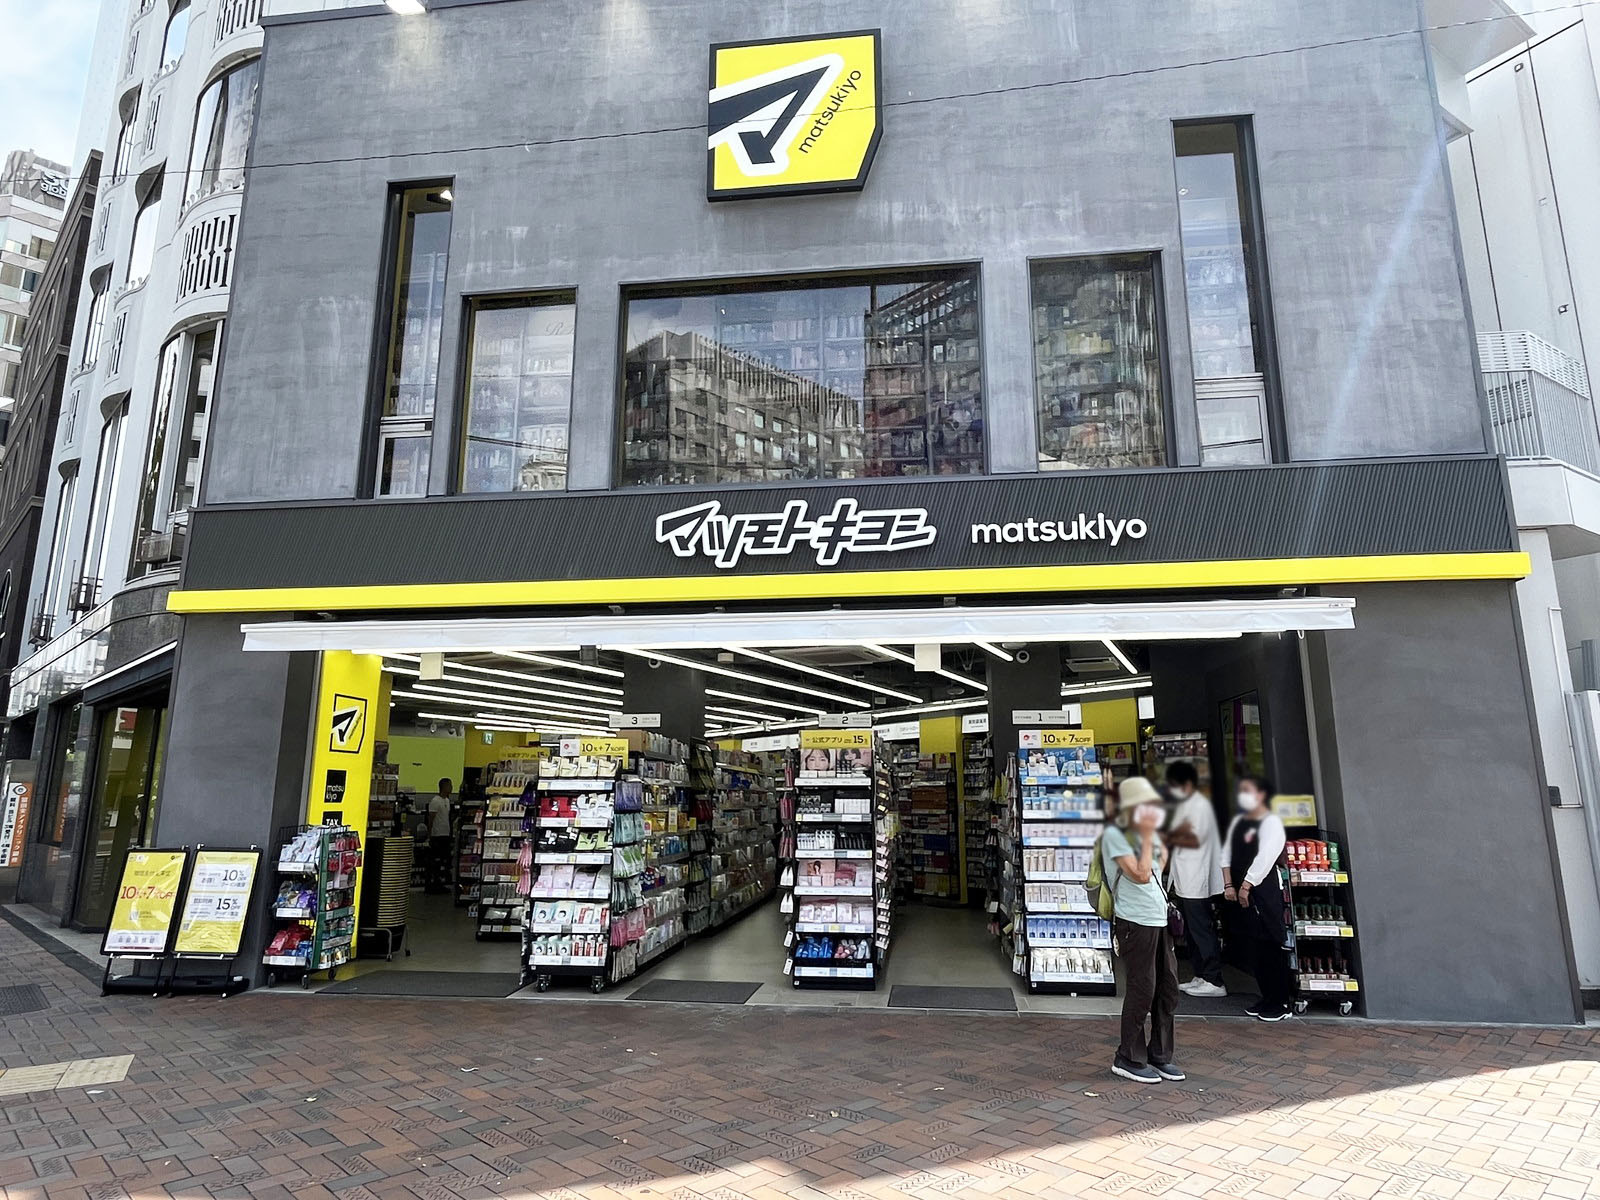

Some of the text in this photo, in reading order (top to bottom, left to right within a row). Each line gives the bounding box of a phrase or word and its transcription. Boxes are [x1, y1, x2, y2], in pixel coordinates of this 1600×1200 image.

[798, 70, 862, 154] matsukiyo
[655, 497, 937, 569] マツモトキヨシ
[971, 512, 1148, 546] matsukiyo
[631, 716, 638, 725] 3
[842, 716, 849, 724] 2
[1038, 713, 1043, 721] 1
[812, 736, 843, 744] 公式アプリ
[327, 784, 344, 792] matsu
[326, 818, 339, 827] TAX
